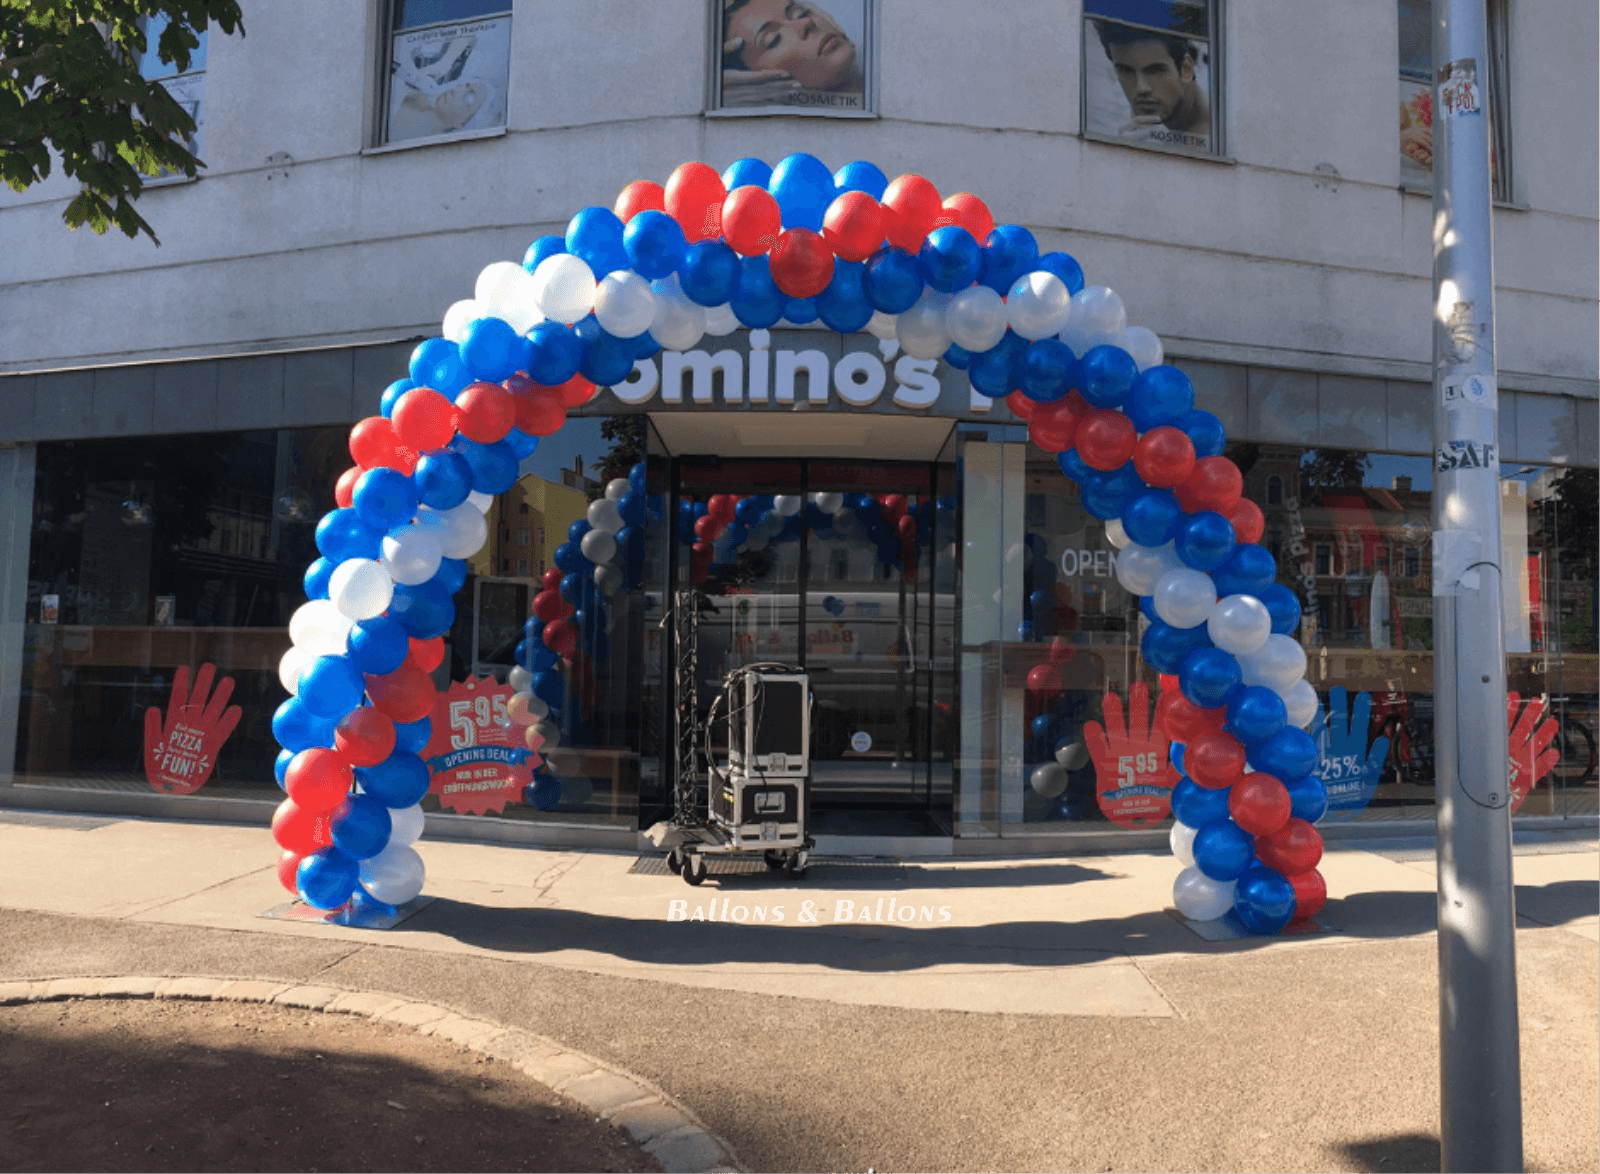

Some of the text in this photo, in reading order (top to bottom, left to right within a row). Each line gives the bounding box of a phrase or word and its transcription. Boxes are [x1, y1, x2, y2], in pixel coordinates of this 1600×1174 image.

[788, 93, 858, 106] KOSMETIK
[1150, 130, 1207, 148] KOSMETIK
[610, 327, 942, 409] omino's
[169, 730, 203, 752] PIZZA
[161, 753, 196, 778] FUN!
[445, 748, 510, 768] OPENING DEAL
